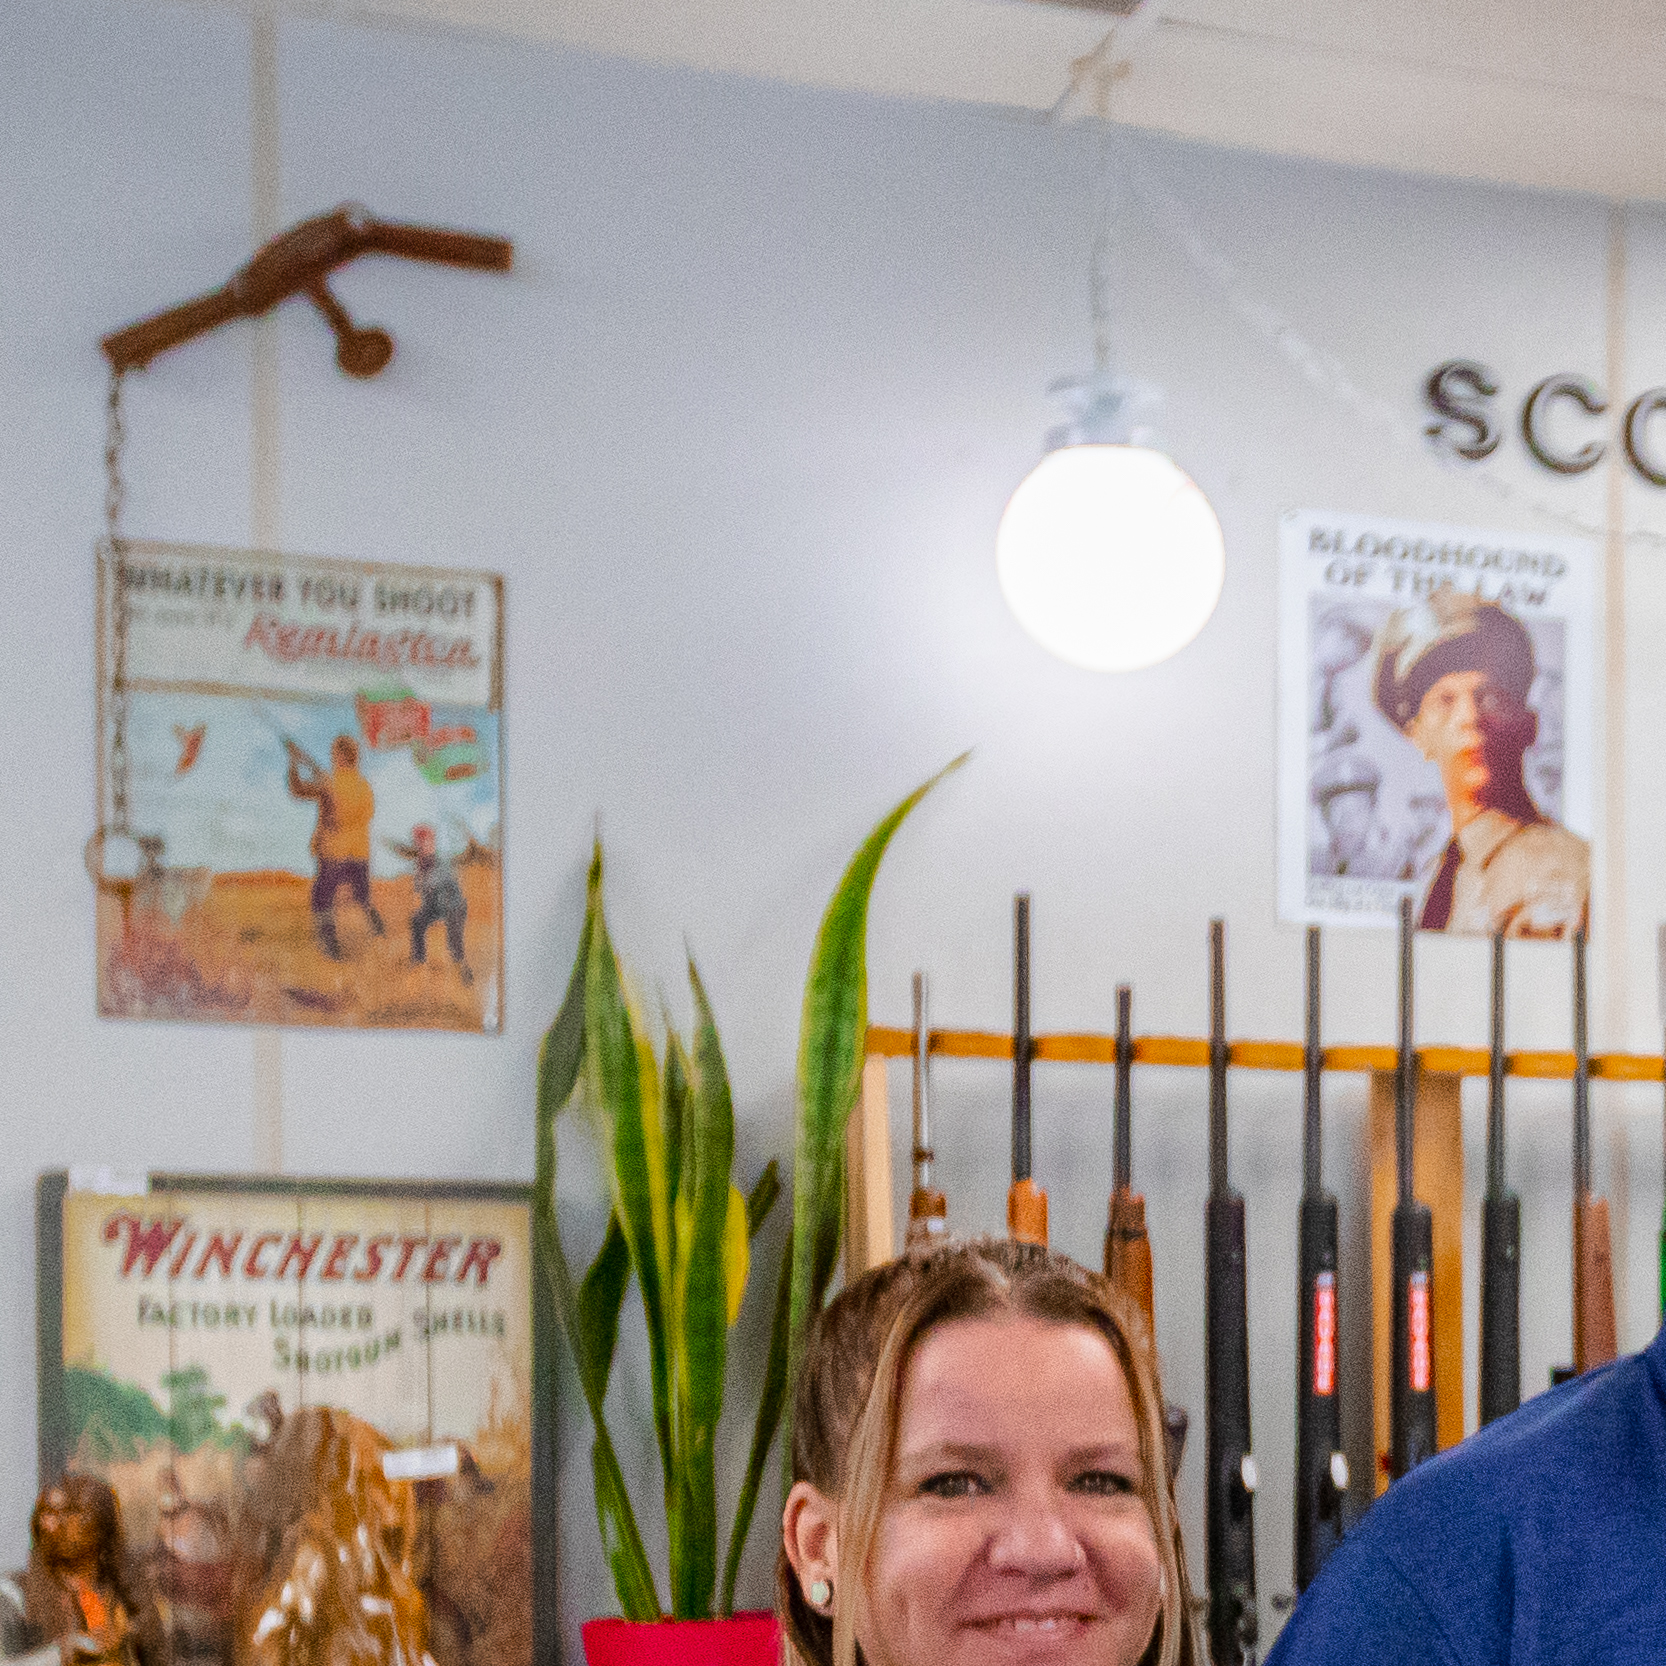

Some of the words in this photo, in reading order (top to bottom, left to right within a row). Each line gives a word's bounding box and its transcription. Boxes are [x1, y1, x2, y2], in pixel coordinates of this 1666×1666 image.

[1308, 526, 1568, 578] BLOODHOUND
[1324, 559, 1377, 585] OF
[301, 575, 359, 609] YOU
[376, 582, 475, 617] SHOOT
[244, 612, 480, 671] Remington
[105, 1212, 501, 1285] WINCHESTER
[137, 1295, 257, 1328] FACTORY
[270, 1299, 373, 1330] LOADED
[273, 1328, 401, 1375] SHOTGUN
[411, 1305, 506, 1343] SHELLS
